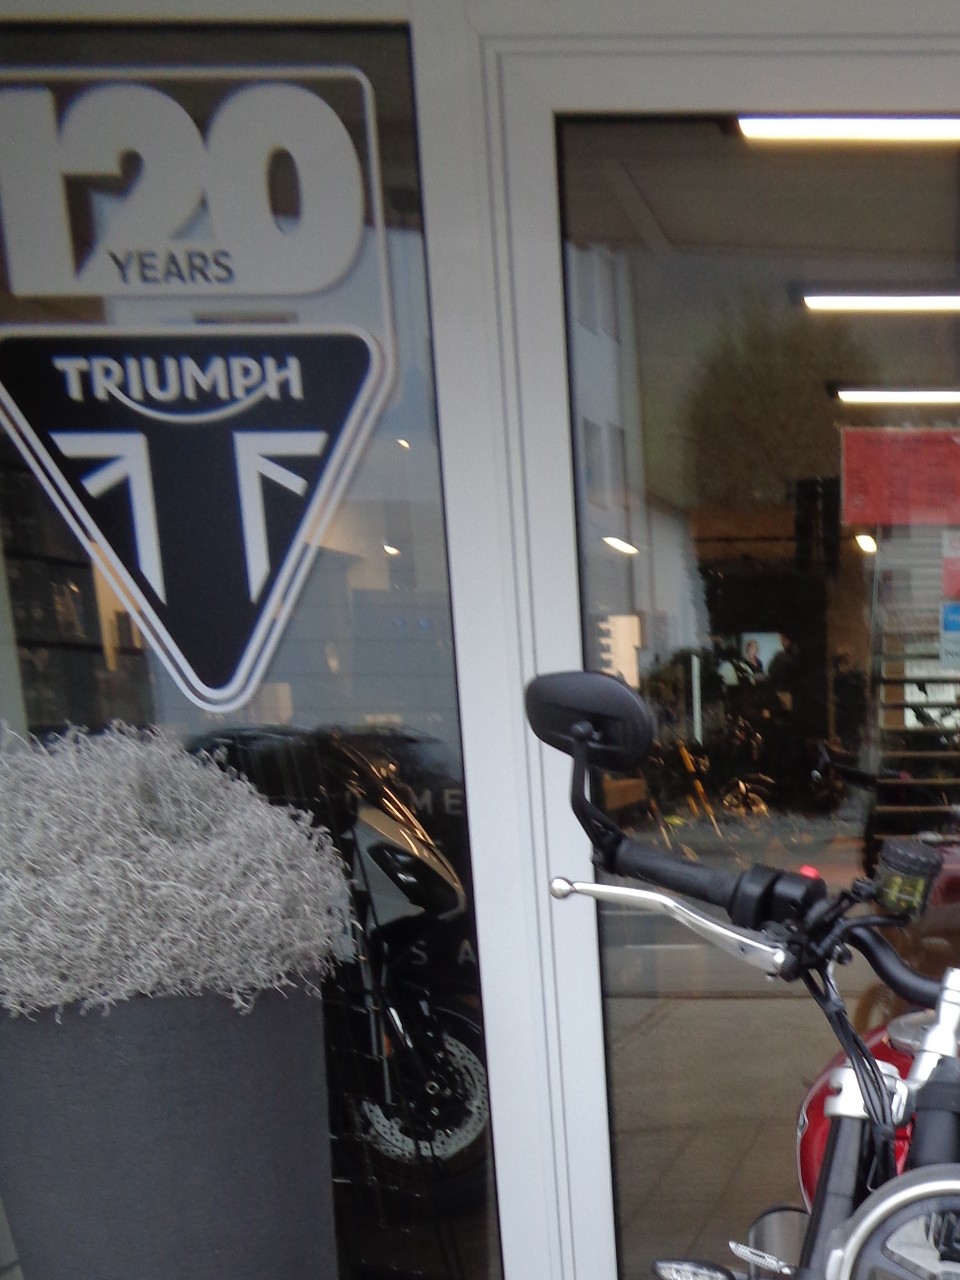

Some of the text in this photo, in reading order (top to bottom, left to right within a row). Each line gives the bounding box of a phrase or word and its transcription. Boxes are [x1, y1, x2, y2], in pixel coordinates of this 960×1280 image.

[0, 82, 364, 297] 120
[108, 250, 236, 284] YEARS
[52, 355, 304, 424] TRIUMPH
